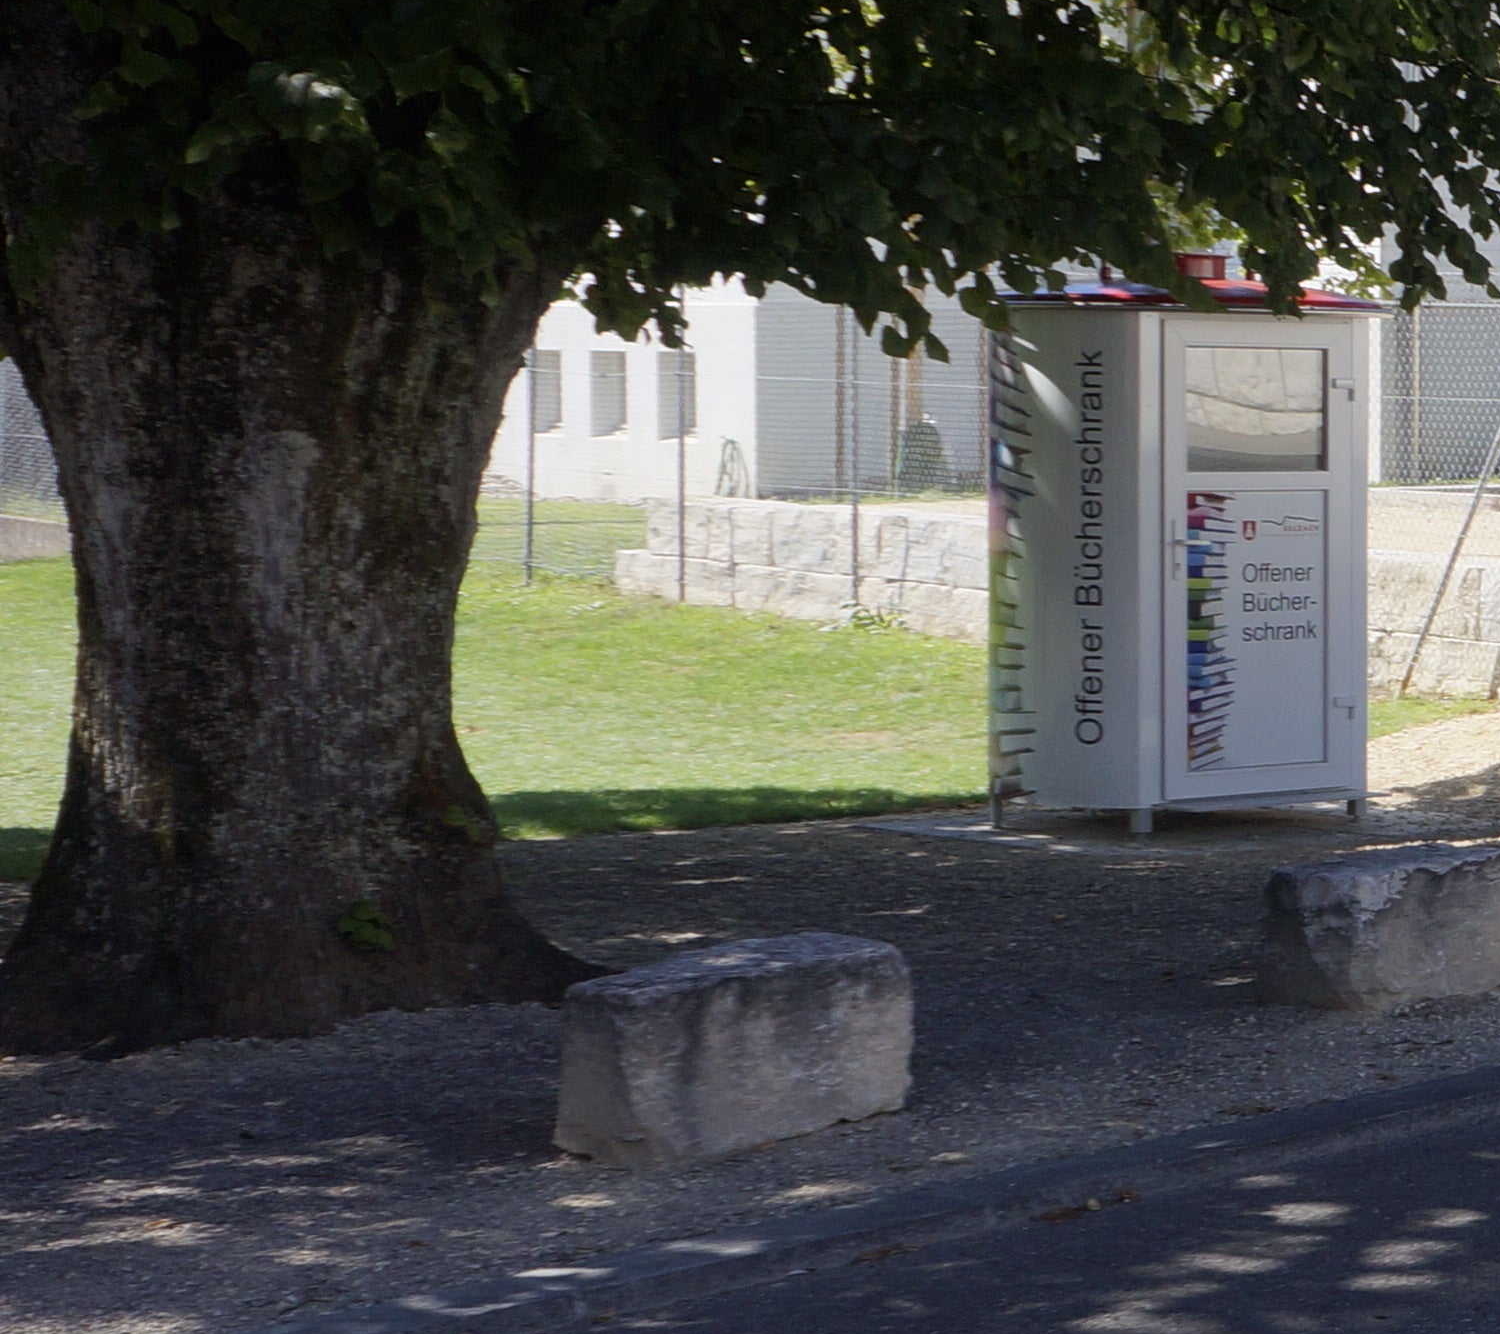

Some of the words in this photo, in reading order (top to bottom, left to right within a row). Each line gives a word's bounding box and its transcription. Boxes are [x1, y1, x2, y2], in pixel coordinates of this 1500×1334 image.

[1073, 350, 1104, 607] Bücherschrank
[1242, 562, 1315, 583] Offener
[1242, 590, 1318, 613] Bücher-
[1242, 619, 1318, 642] schrank
[1074, 618, 1104, 746] Offener
